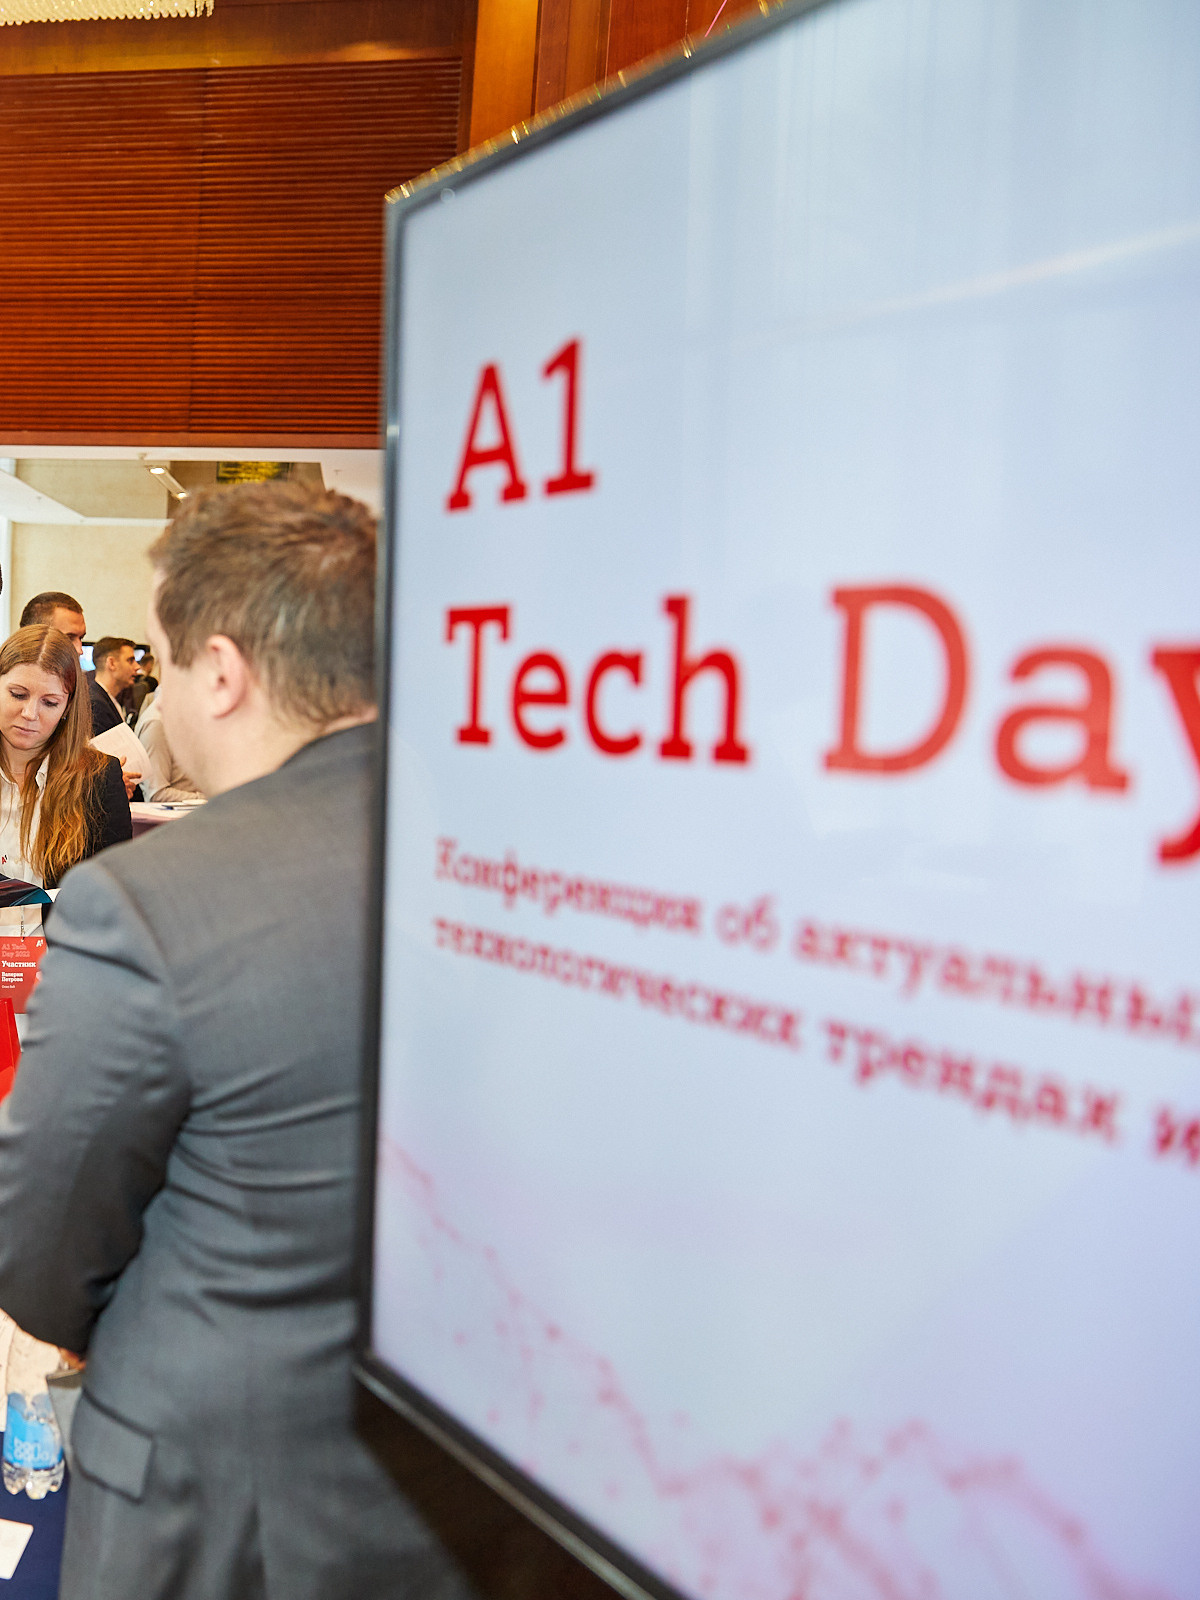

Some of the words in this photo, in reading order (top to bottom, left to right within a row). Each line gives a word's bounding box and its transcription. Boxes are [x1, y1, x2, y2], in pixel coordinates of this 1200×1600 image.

[446, 336, 596, 513] A1
[444, 594, 751, 766] Tech
[1, 854, 8, 865] A1
[435, 836, 702, 936] Конференция
[714, 894, 779, 954] об
[1, 960, 36, 968] Участник
[434, 916, 803, 1052] технологических
[824, 1016, 1119, 1148] трендах
